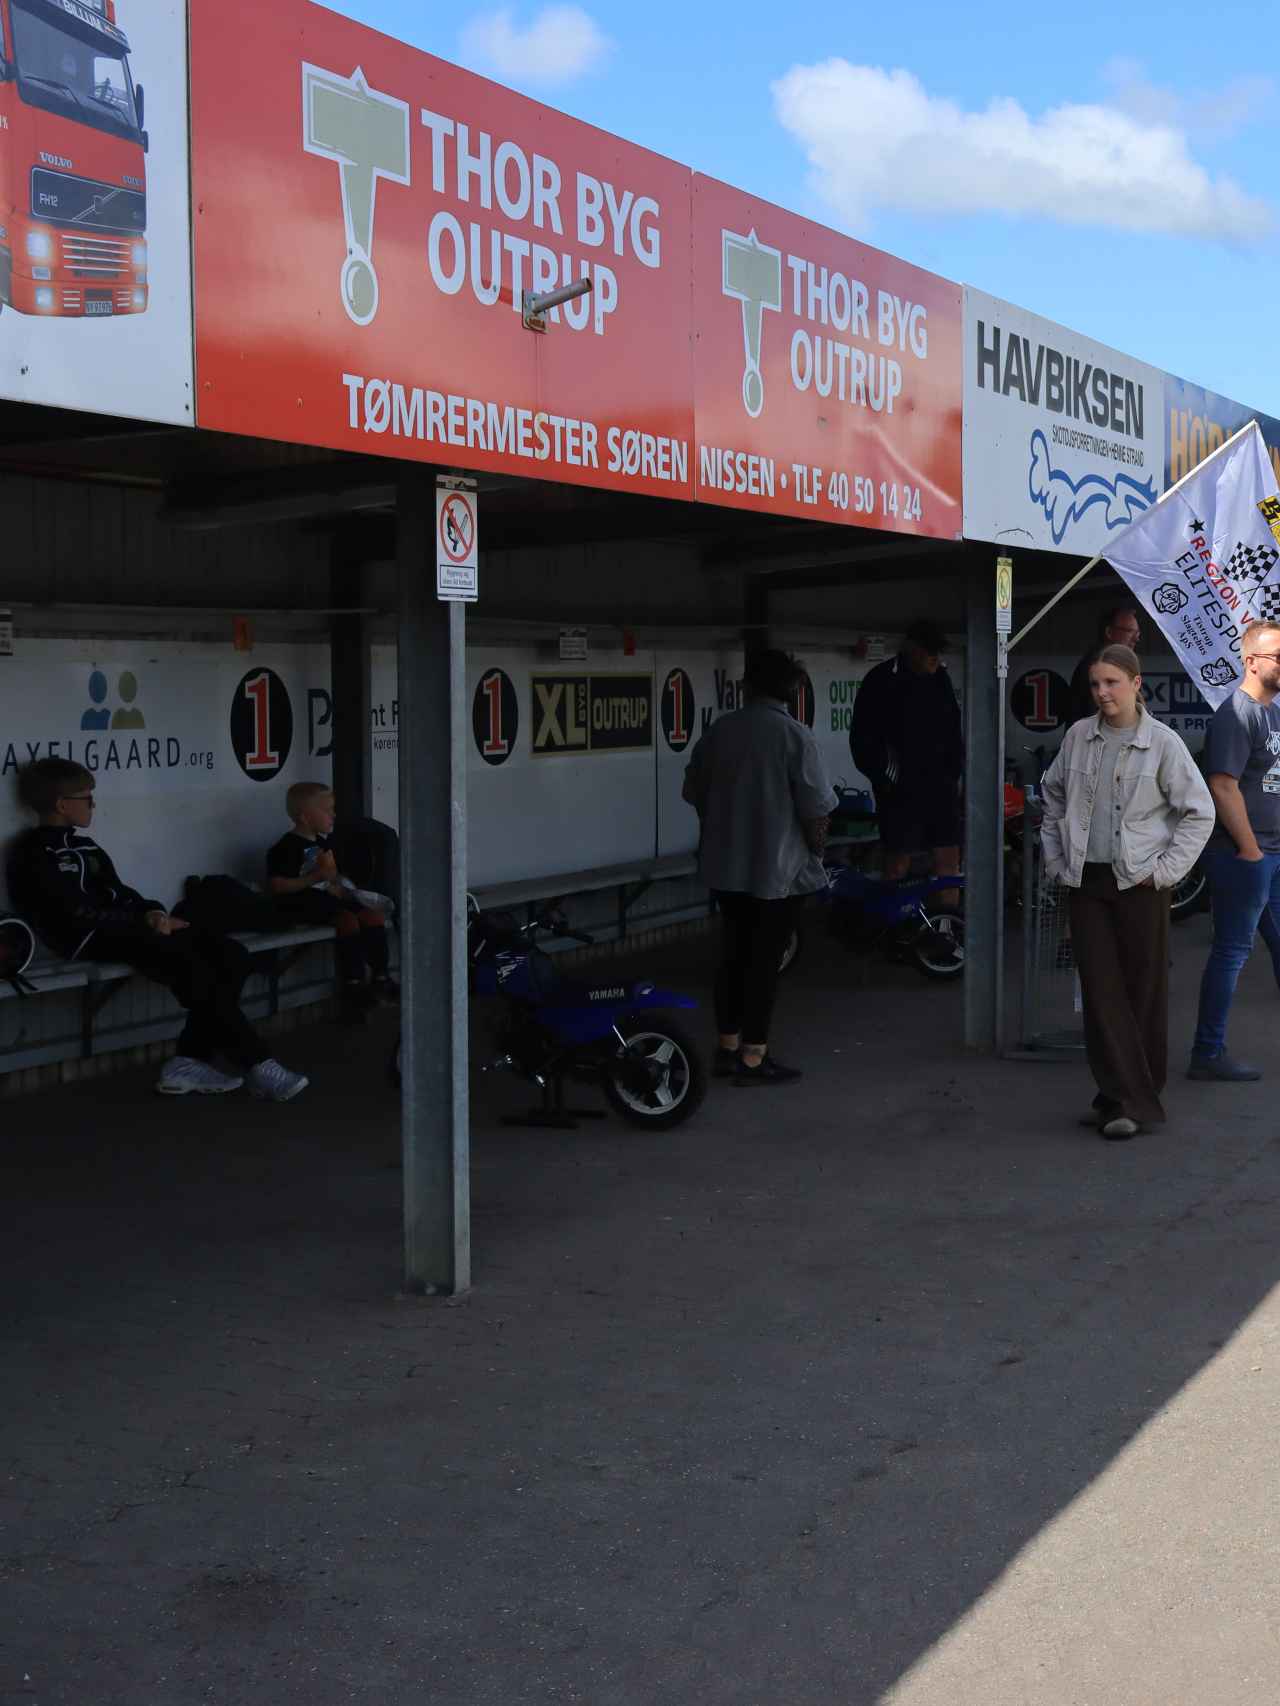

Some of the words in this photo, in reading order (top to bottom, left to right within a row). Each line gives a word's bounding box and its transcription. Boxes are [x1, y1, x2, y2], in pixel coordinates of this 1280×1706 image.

[39, 152, 73, 169] VOLVO
[39, 193, 59, 207] FH12
[422, 108, 563, 236] THOR
[577, 171, 661, 268] BYG
[428, 211, 619, 335] OUTRUP
[788, 255, 870, 339] THOR
[878, 289, 927, 360] BYG
[791, 329, 903, 414] OUTRUP
[976, 320, 1144, 440] HAVBIKSEN
[343, 374, 599, 469] TØMRERMESTER
[607, 427, 688, 483] SØREN
[700, 446, 775, 497] NISSEN
[792, 463, 822, 504] TLF
[828, 476, 849, 509] 40
[855, 481, 874, 513] 50
[880, 483, 898, 518] 14
[904, 488, 922, 521] 24
[1175, 551, 1242, 665] ELITESPO
[1190, 534, 1242, 611] REGION
[1193, 614, 1214, 648] Tistrup
[246, 672, 280, 770] 1
[483, 673, 508, 756] 1
[533, 682, 587, 748] XL
[593, 695, 648, 731] OUTRUP
[669, 672, 688, 744] 1
[1024, 672, 1058, 726] 1
[589, 988, 625, 1001] YAMAHA
